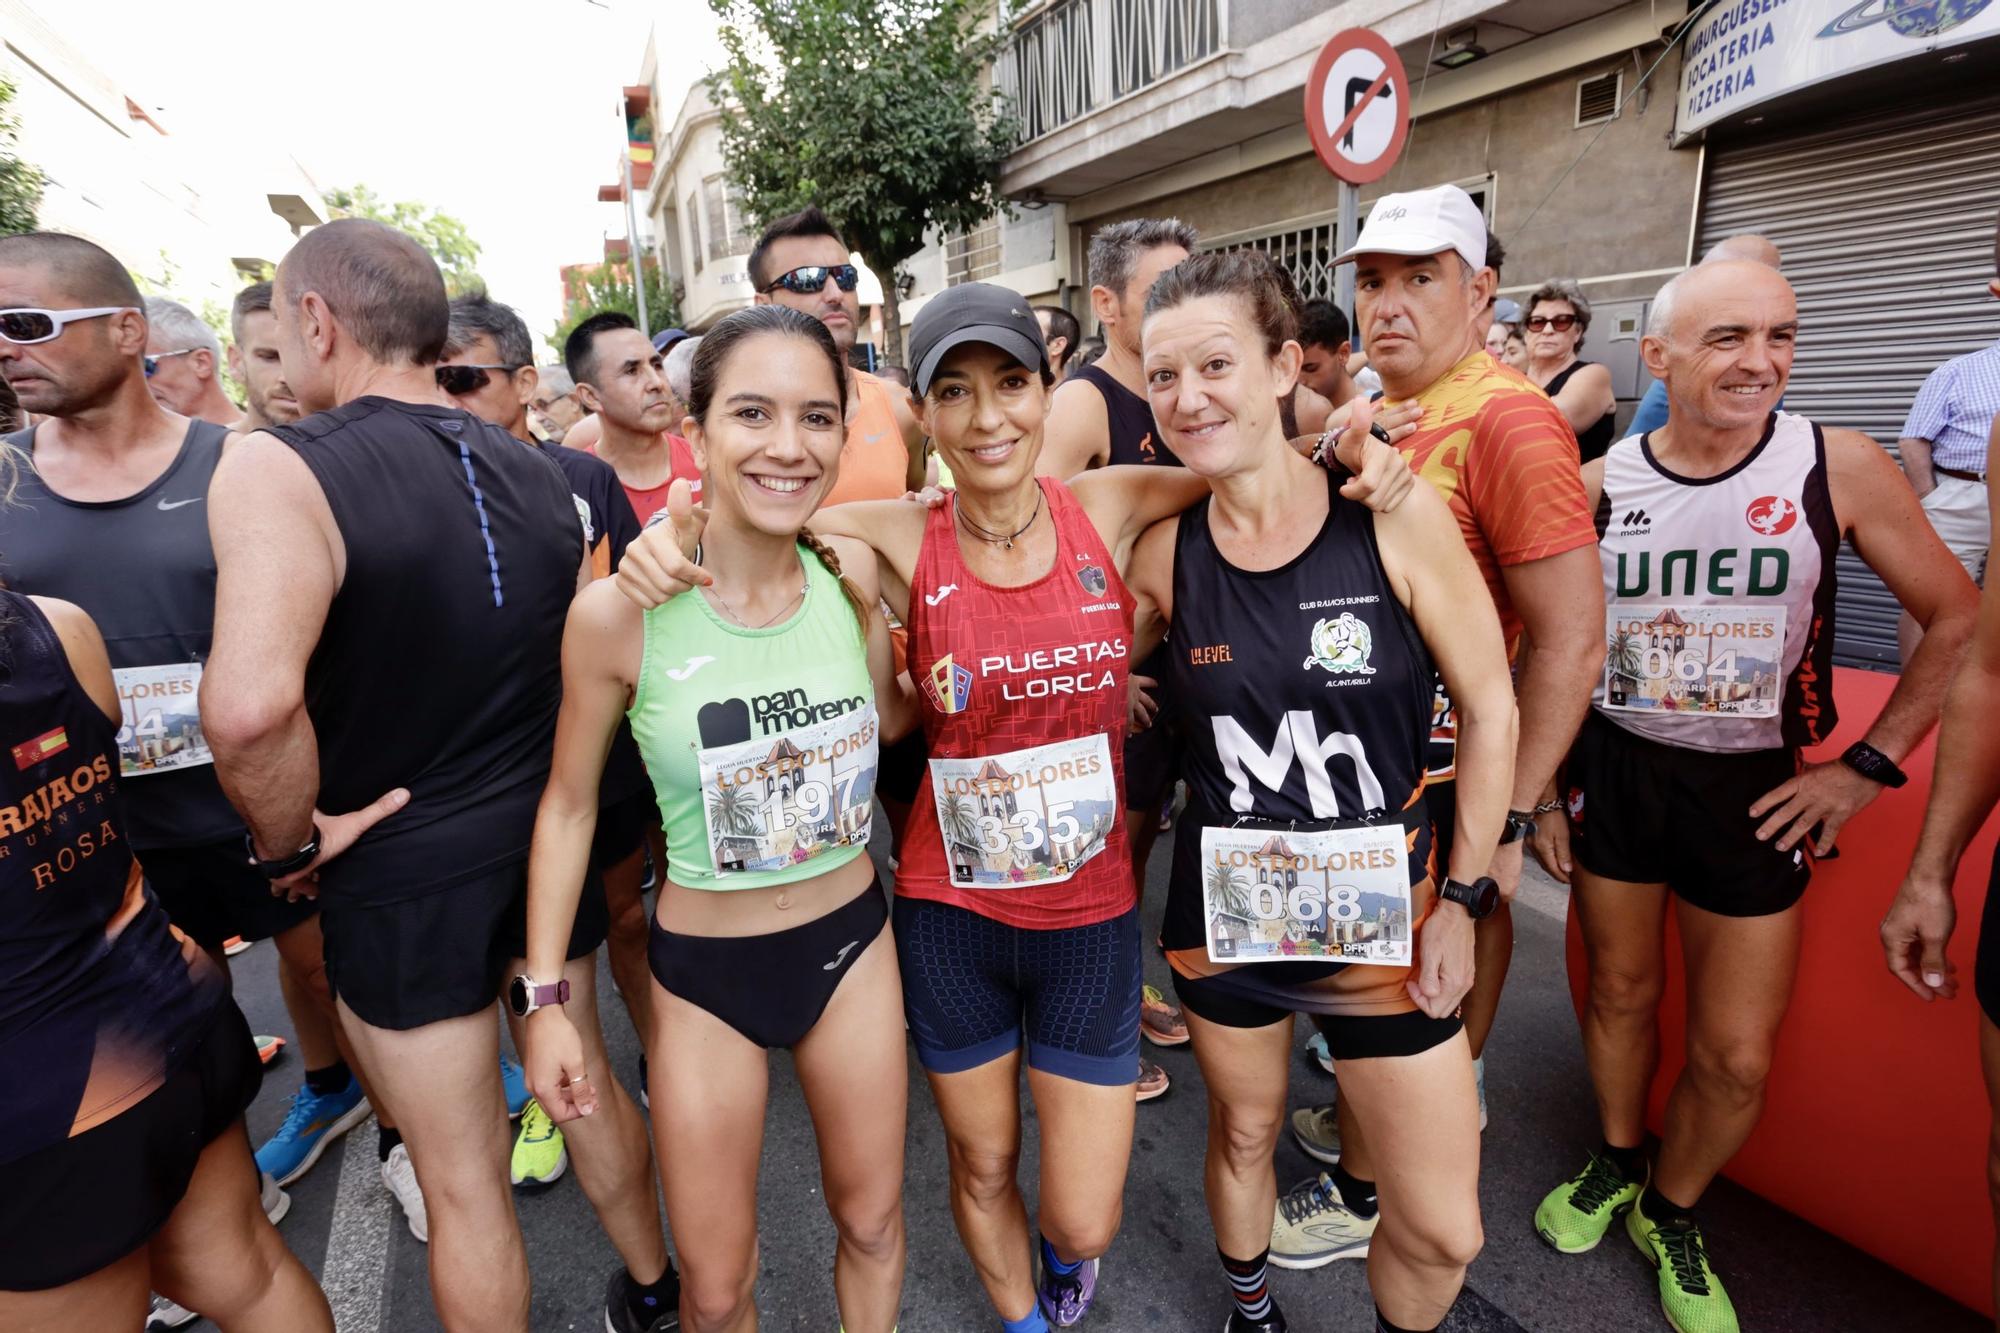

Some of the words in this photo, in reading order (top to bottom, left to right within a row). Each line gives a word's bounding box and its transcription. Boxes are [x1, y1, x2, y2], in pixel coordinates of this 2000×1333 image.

[1687, 65, 1755, 117] PIZZERIA
[1621, 528, 1651, 537] mobel
[1617, 548, 1790, 597] UNED
[1081, 603, 1107, 614] PUERTAS
[1299, 601, 1316, 610] CLUB
[1317, 598, 1345, 608] RAMOS
[1346, 595, 1380, 604] RUNNERS
[1616, 620, 1655, 636] LOS
[1662, 622, 1775, 638] DOLORES
[981, 638, 1127, 677] PUERTAS
[1640, 648, 1740, 682] 064
[119, 679, 194, 700] LORES
[1002, 670, 1116, 701] LORCA
[1325, 678, 1371, 688] ALCANTARILLA
[751, 687, 809, 724] pan
[717, 763, 769, 791] LOS
[777, 720, 875, 773] DOLORES
[943, 777, 980, 796] LOS
[989, 755, 1102, 794] DOLORES
[758, 765, 860, 833] 197
[0, 782, 117, 859] RUNNERS
[976, 800, 1080, 855] 335
[31, 820, 118, 891] ROSA
[1215, 849, 1260, 868] LOS
[1271, 848, 1397, 872] DOLORES
[1250, 883, 1362, 922] 068
[1294, 924, 1320, 933] ANA
[1343, 944, 1368, 954] DFM
